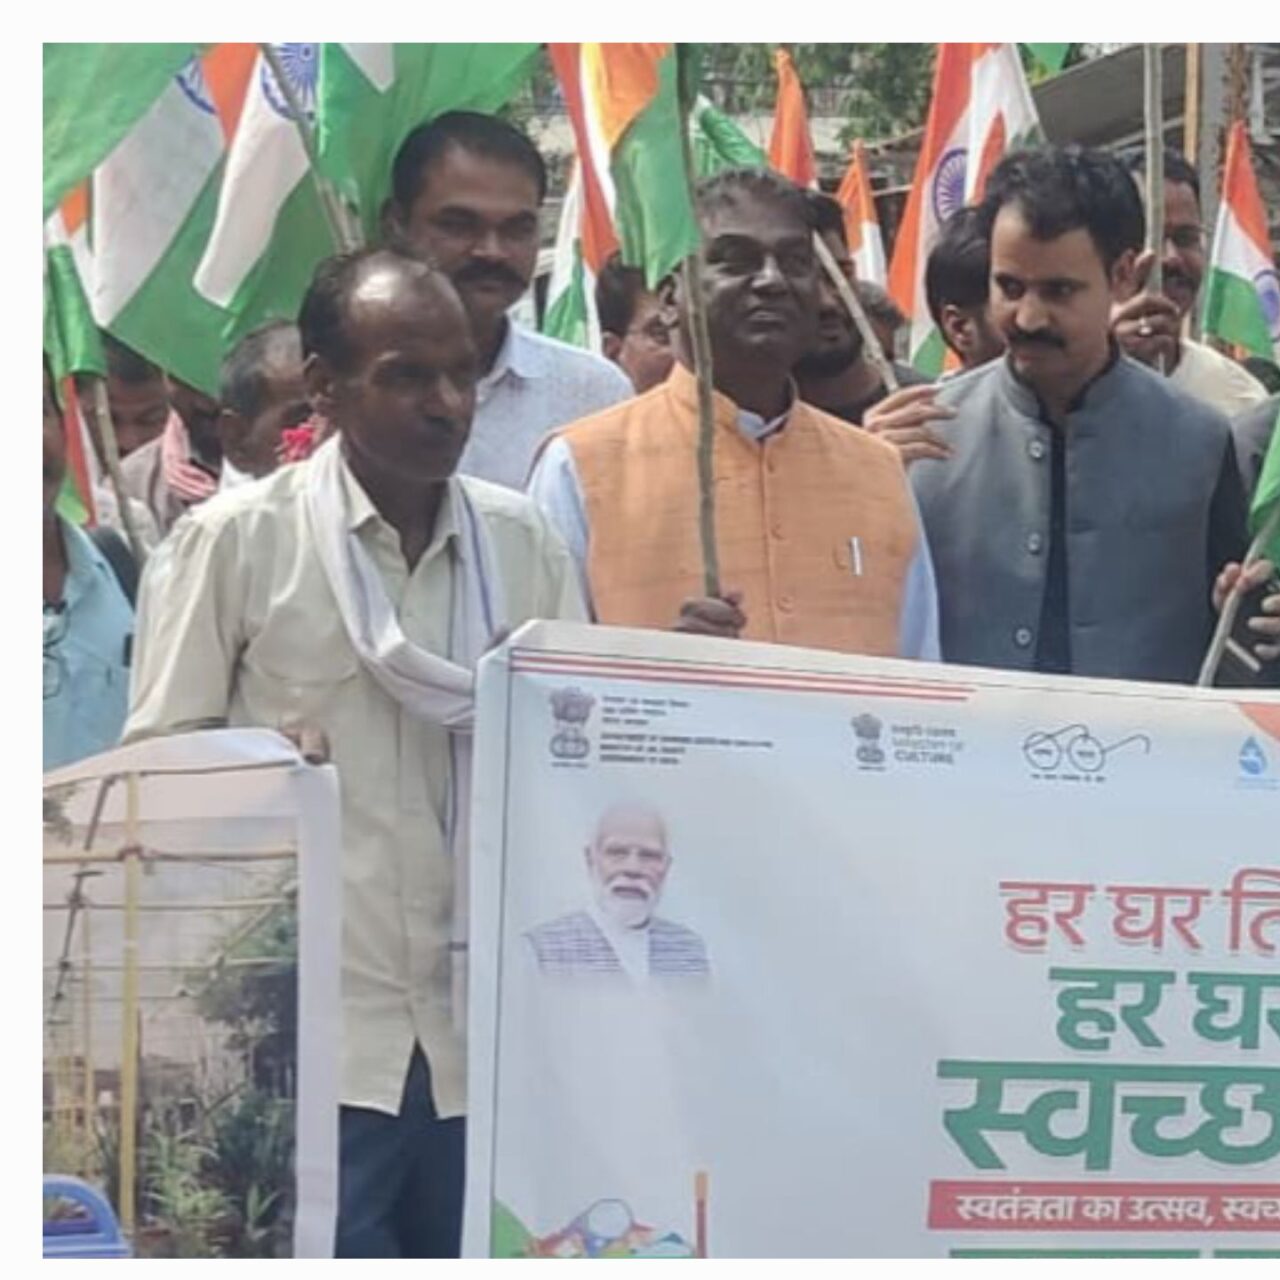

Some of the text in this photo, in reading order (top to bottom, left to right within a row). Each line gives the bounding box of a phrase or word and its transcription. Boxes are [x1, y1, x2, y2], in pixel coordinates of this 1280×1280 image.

[999, 881, 1096, 948] हर
[1105, 886, 1212, 951] घर
[1049, 967, 1176, 1051] हर
[955, 1186, 1077, 1220] स्वतंत्रता
[1078, 1195, 1123, 1220] का
[1127, 1195, 1214, 1226] उत्सव,
